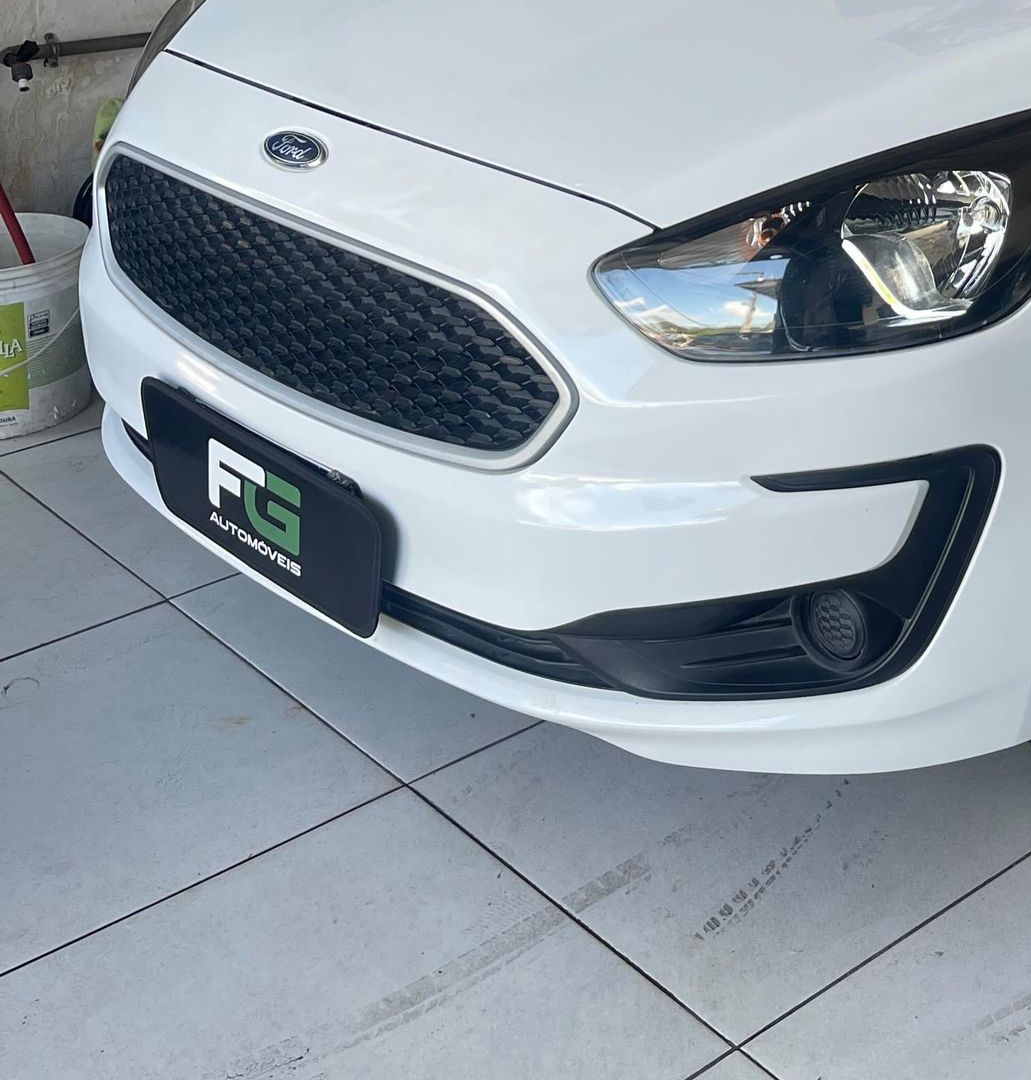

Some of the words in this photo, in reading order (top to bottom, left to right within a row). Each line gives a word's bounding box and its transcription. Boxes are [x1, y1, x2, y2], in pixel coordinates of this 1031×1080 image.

[271, 134, 312, 160] Ford
[208, 437, 301, 557] FG
[209, 510, 302, 577] AUTOMÓVEIS
